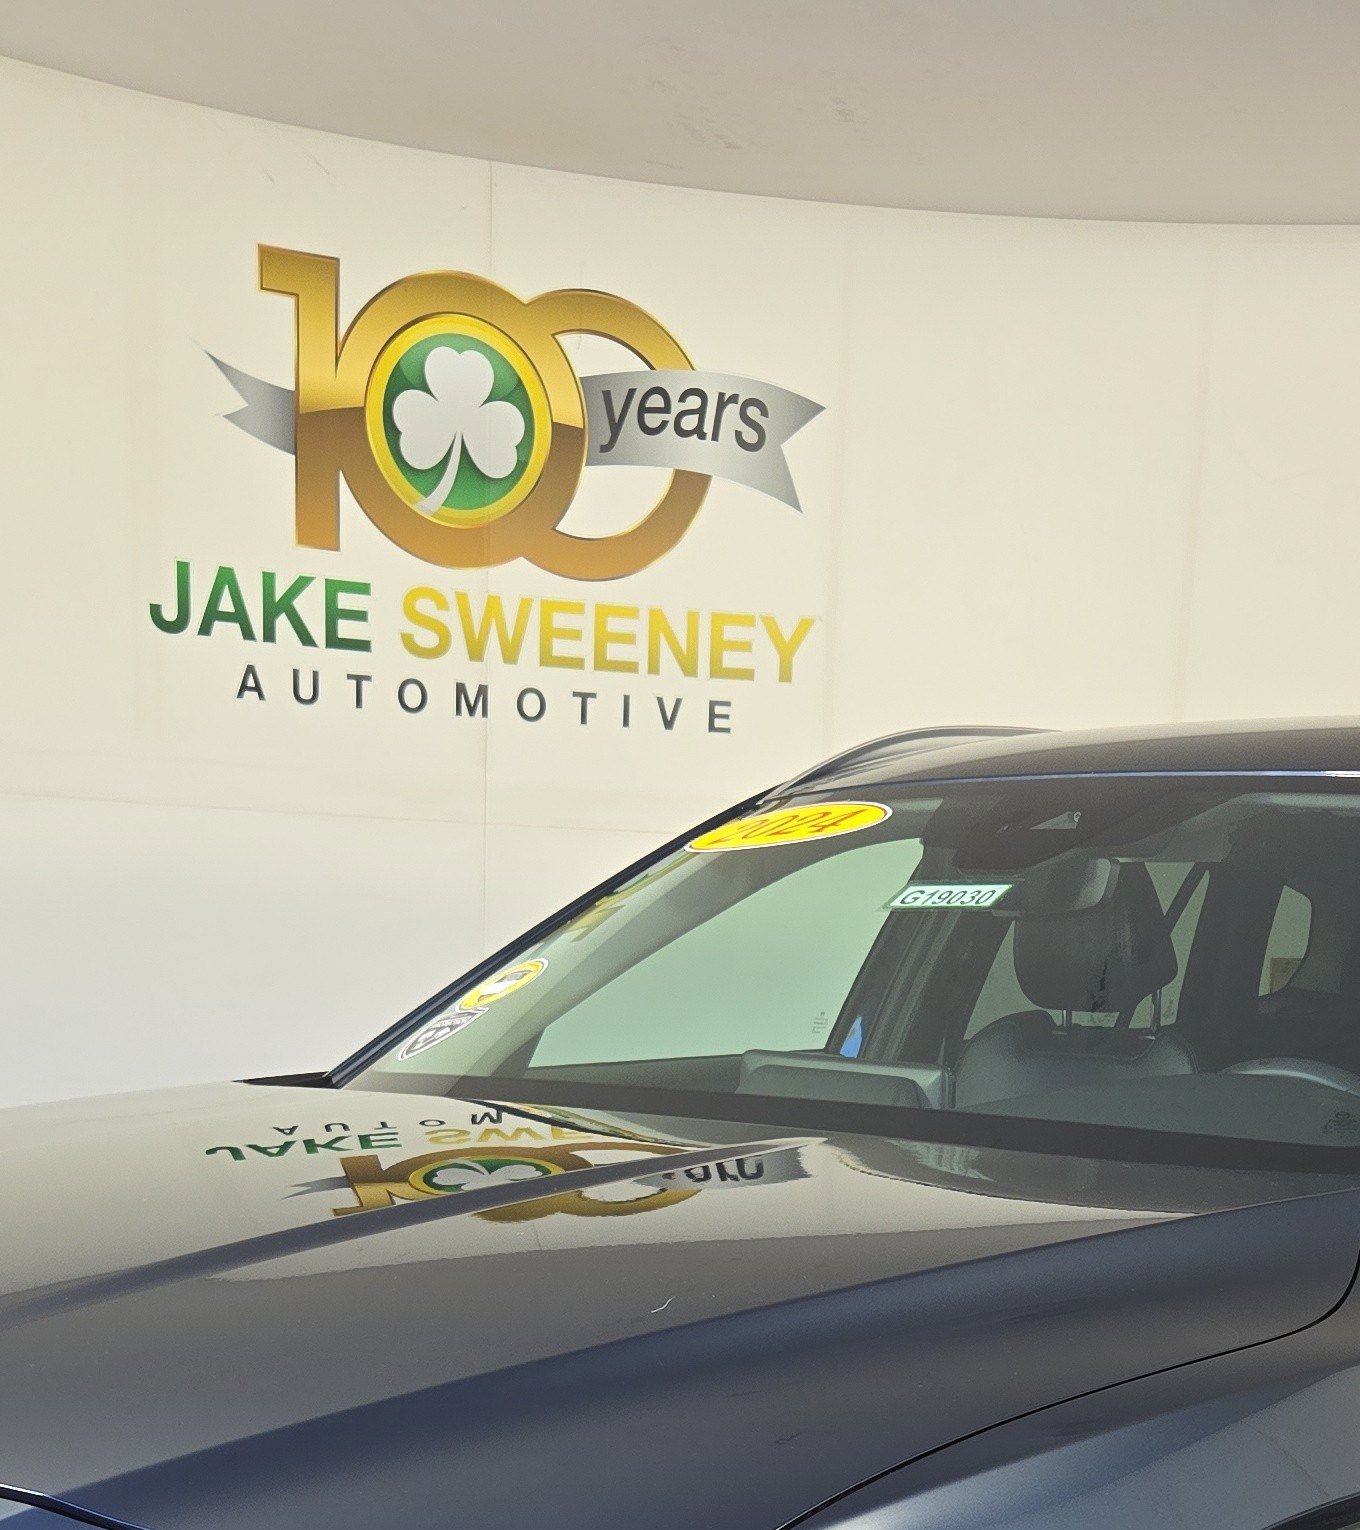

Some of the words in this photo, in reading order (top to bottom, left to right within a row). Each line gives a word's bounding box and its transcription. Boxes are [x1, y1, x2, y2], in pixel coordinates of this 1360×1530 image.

[257, 242, 716, 581] 100
[597, 383, 770, 455] years
[149, 556, 372, 654] JAKE
[400, 585, 816, 684] SWEENEY
[236, 663, 732, 734] AUTOMOTIVE
[706, 808, 868, 845] 2024
[900, 888, 997, 905] G19030
